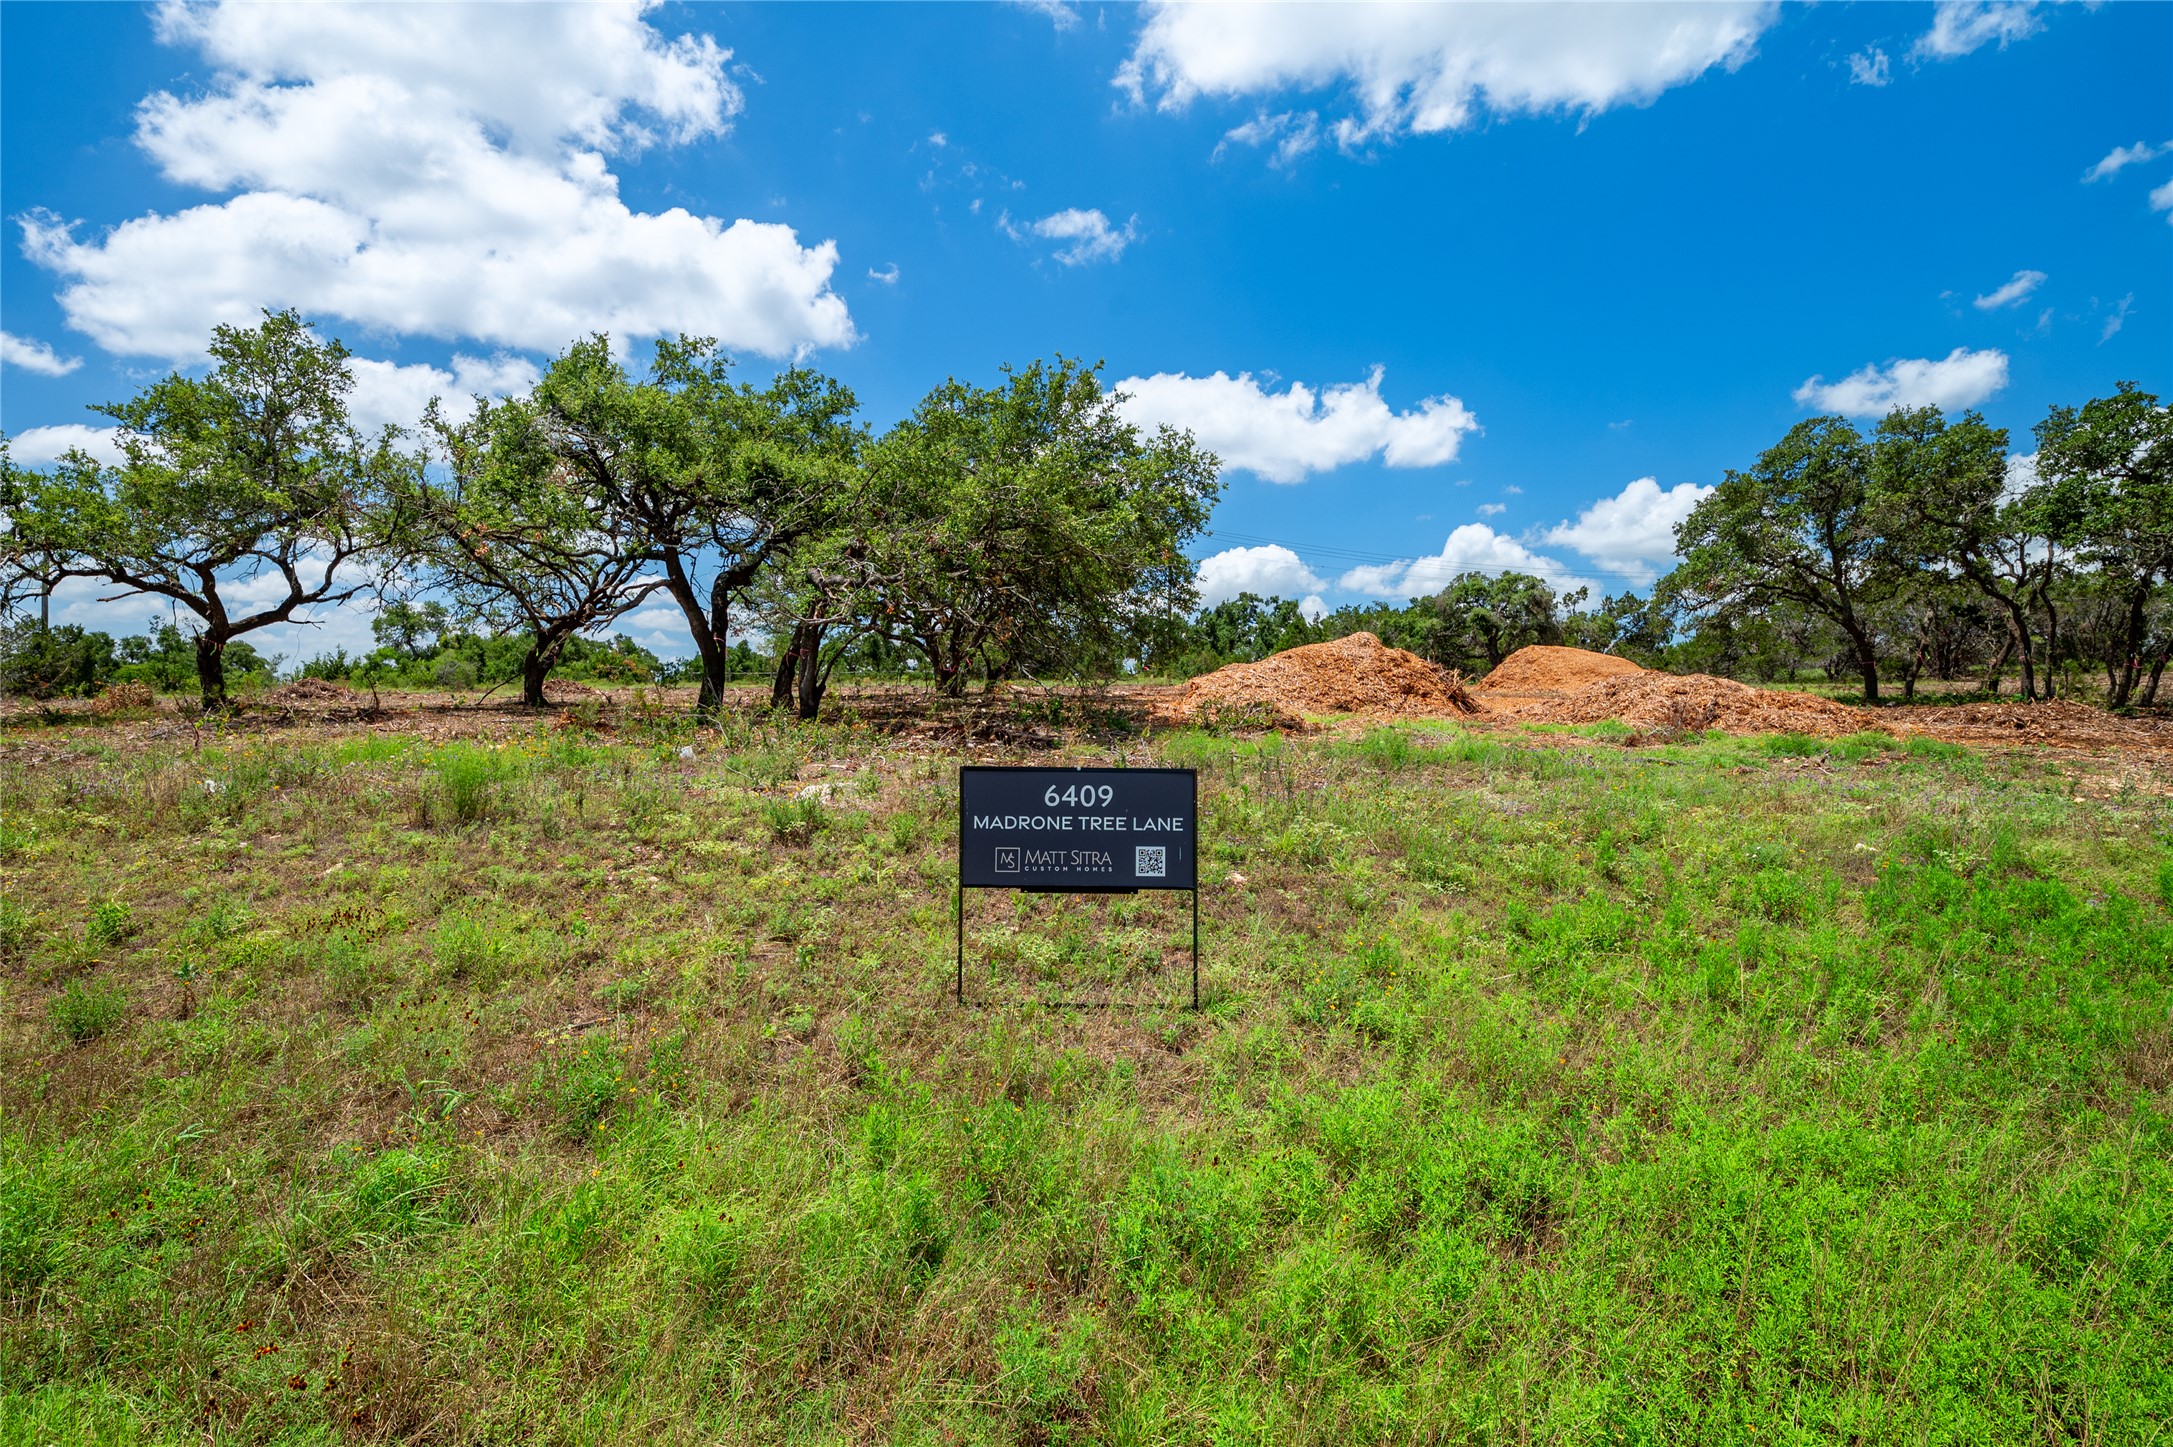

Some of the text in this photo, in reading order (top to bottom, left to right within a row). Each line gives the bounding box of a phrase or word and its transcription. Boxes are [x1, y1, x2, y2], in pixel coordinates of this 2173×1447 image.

[1044, 784, 1114, 808] 6409
[973, 815, 1184, 832] MADRONE TREE LANE
[1025, 849, 1112, 865] MATT SITRA
